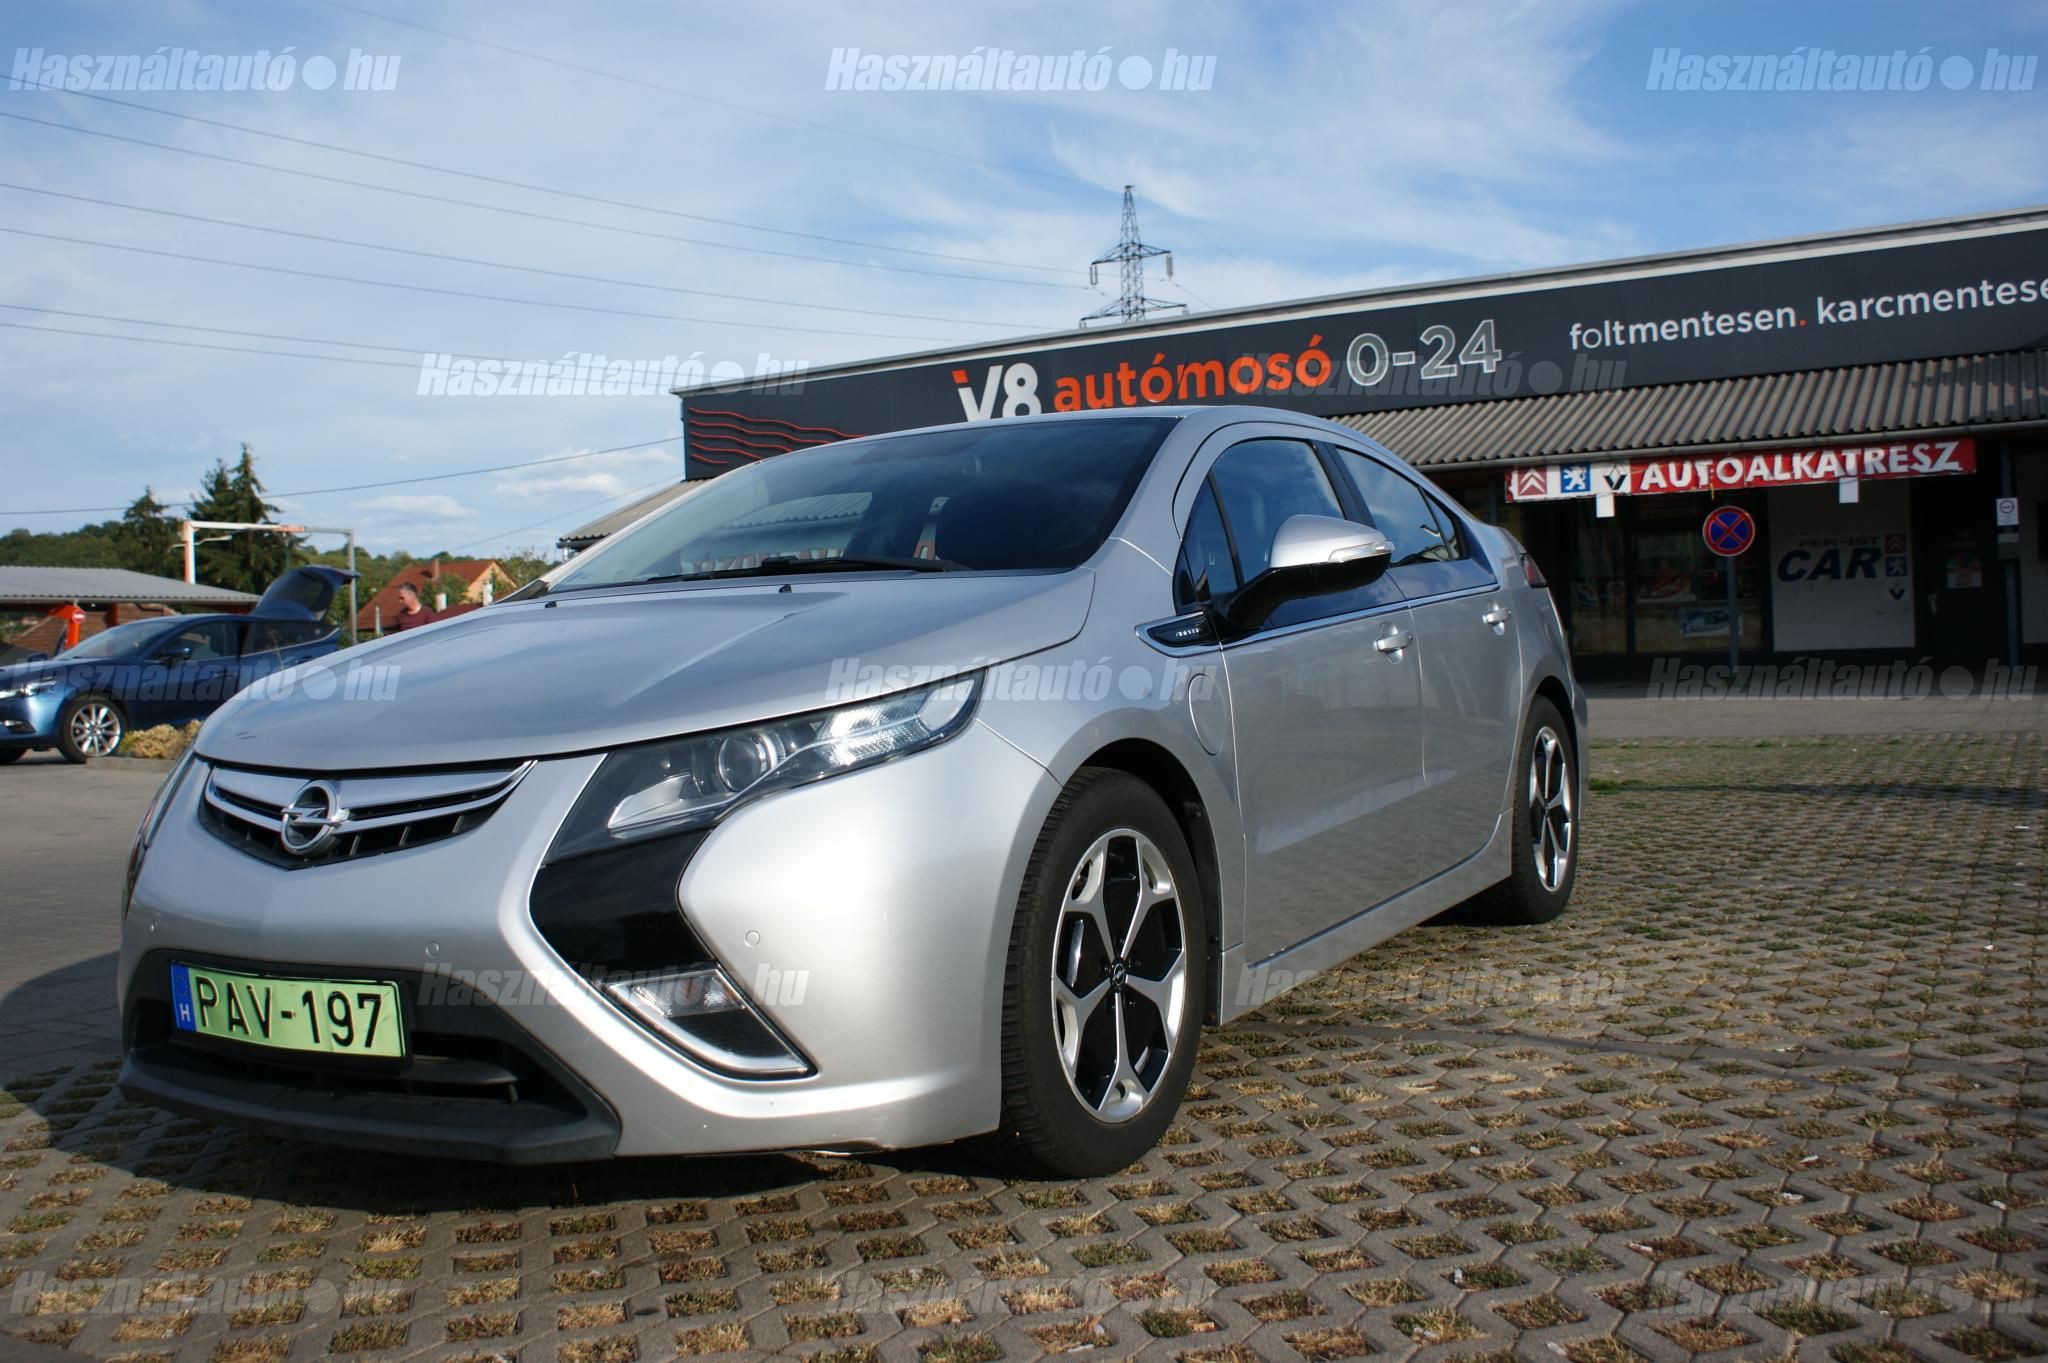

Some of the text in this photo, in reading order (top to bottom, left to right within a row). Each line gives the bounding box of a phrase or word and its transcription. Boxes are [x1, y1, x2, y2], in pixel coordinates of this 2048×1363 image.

[1053, 334, 1332, 413] autómosó
[1346, 319, 1503, 388] 0-24
[1570, 303, 1806, 350] foltmentesen.
[1777, 547, 1883, 582] CAR
[180, 975, 382, 1048] H PAV-197
